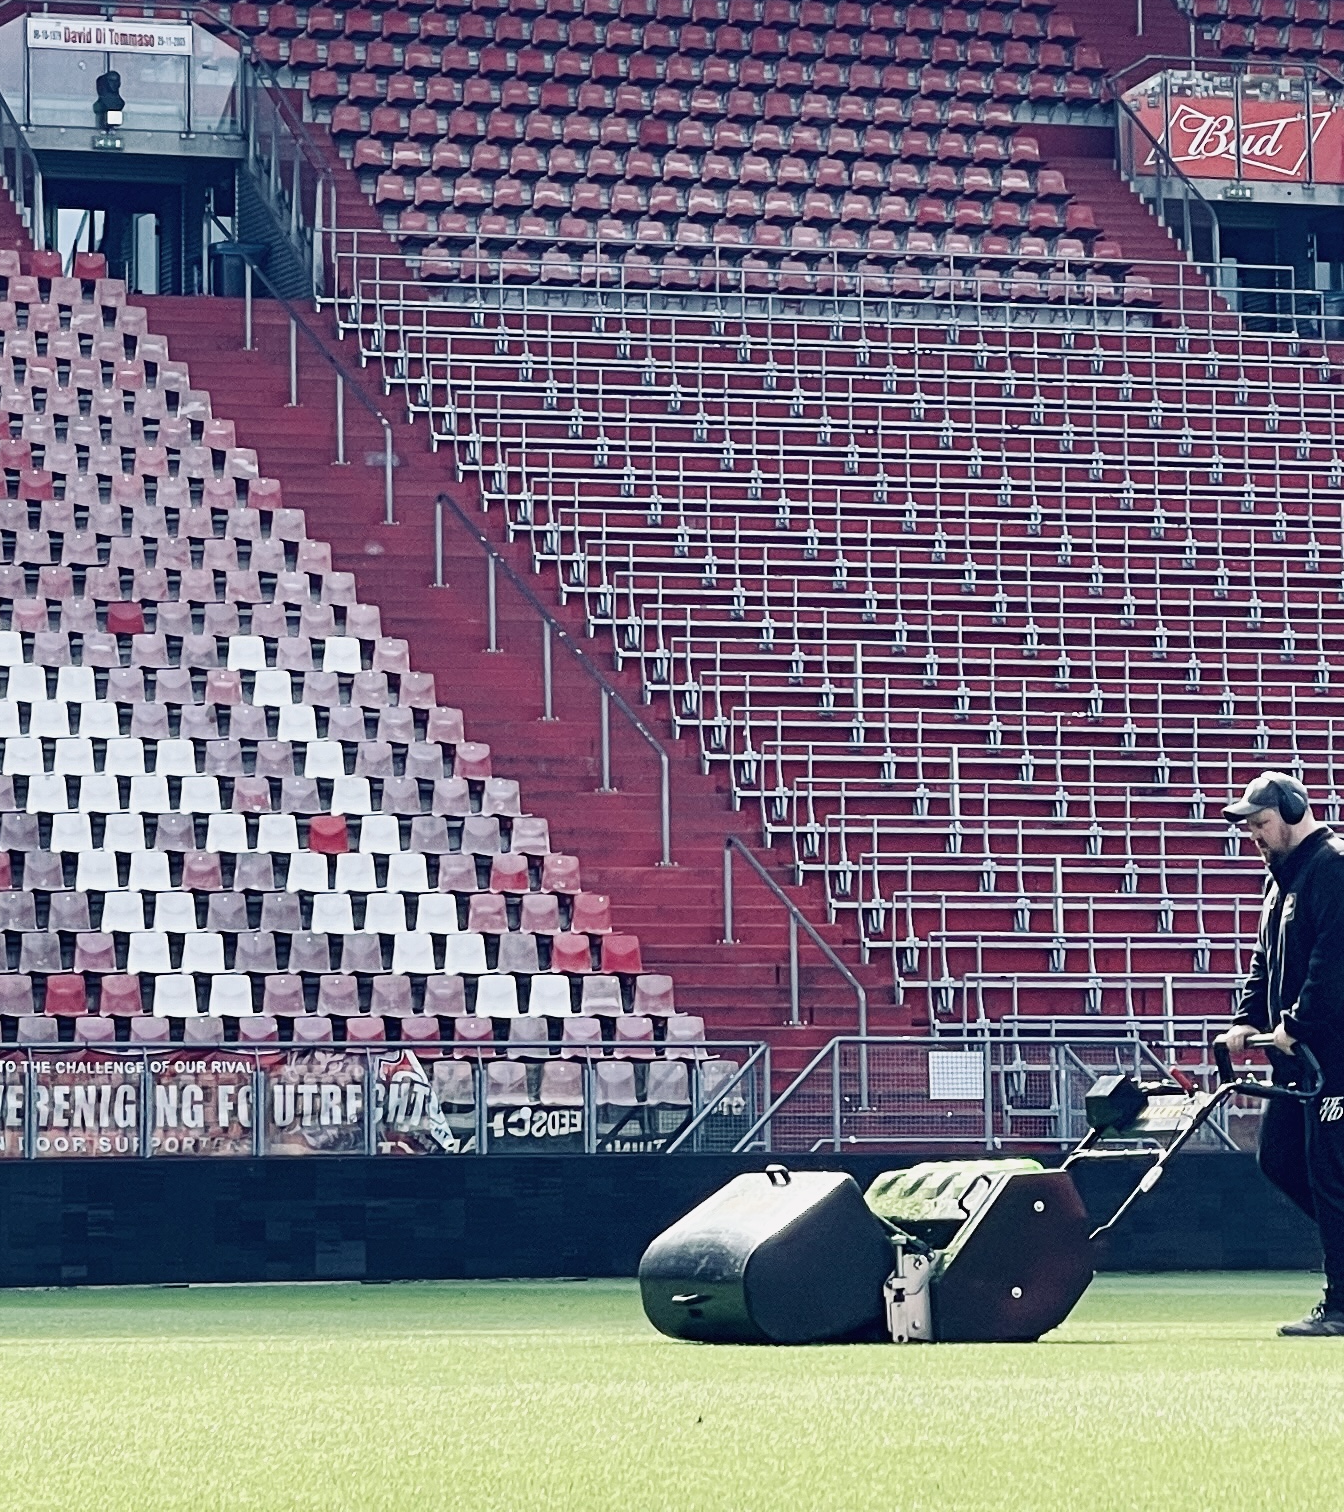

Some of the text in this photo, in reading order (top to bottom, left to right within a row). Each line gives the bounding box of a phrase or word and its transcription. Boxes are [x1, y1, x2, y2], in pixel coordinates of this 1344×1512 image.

[64, 26, 92, 44] David
[108, 29, 155, 47] Tommaso
[1180, 115, 1287, 156] Bud
[20, 1061, 50, 1074] THE
[55, 1061, 145, 1075] CHALLENGE
[150, 1061, 170, 1074] OF
[173, 1061, 206, 1074] OUR
[19, 1136, 87, 1152] OOR
